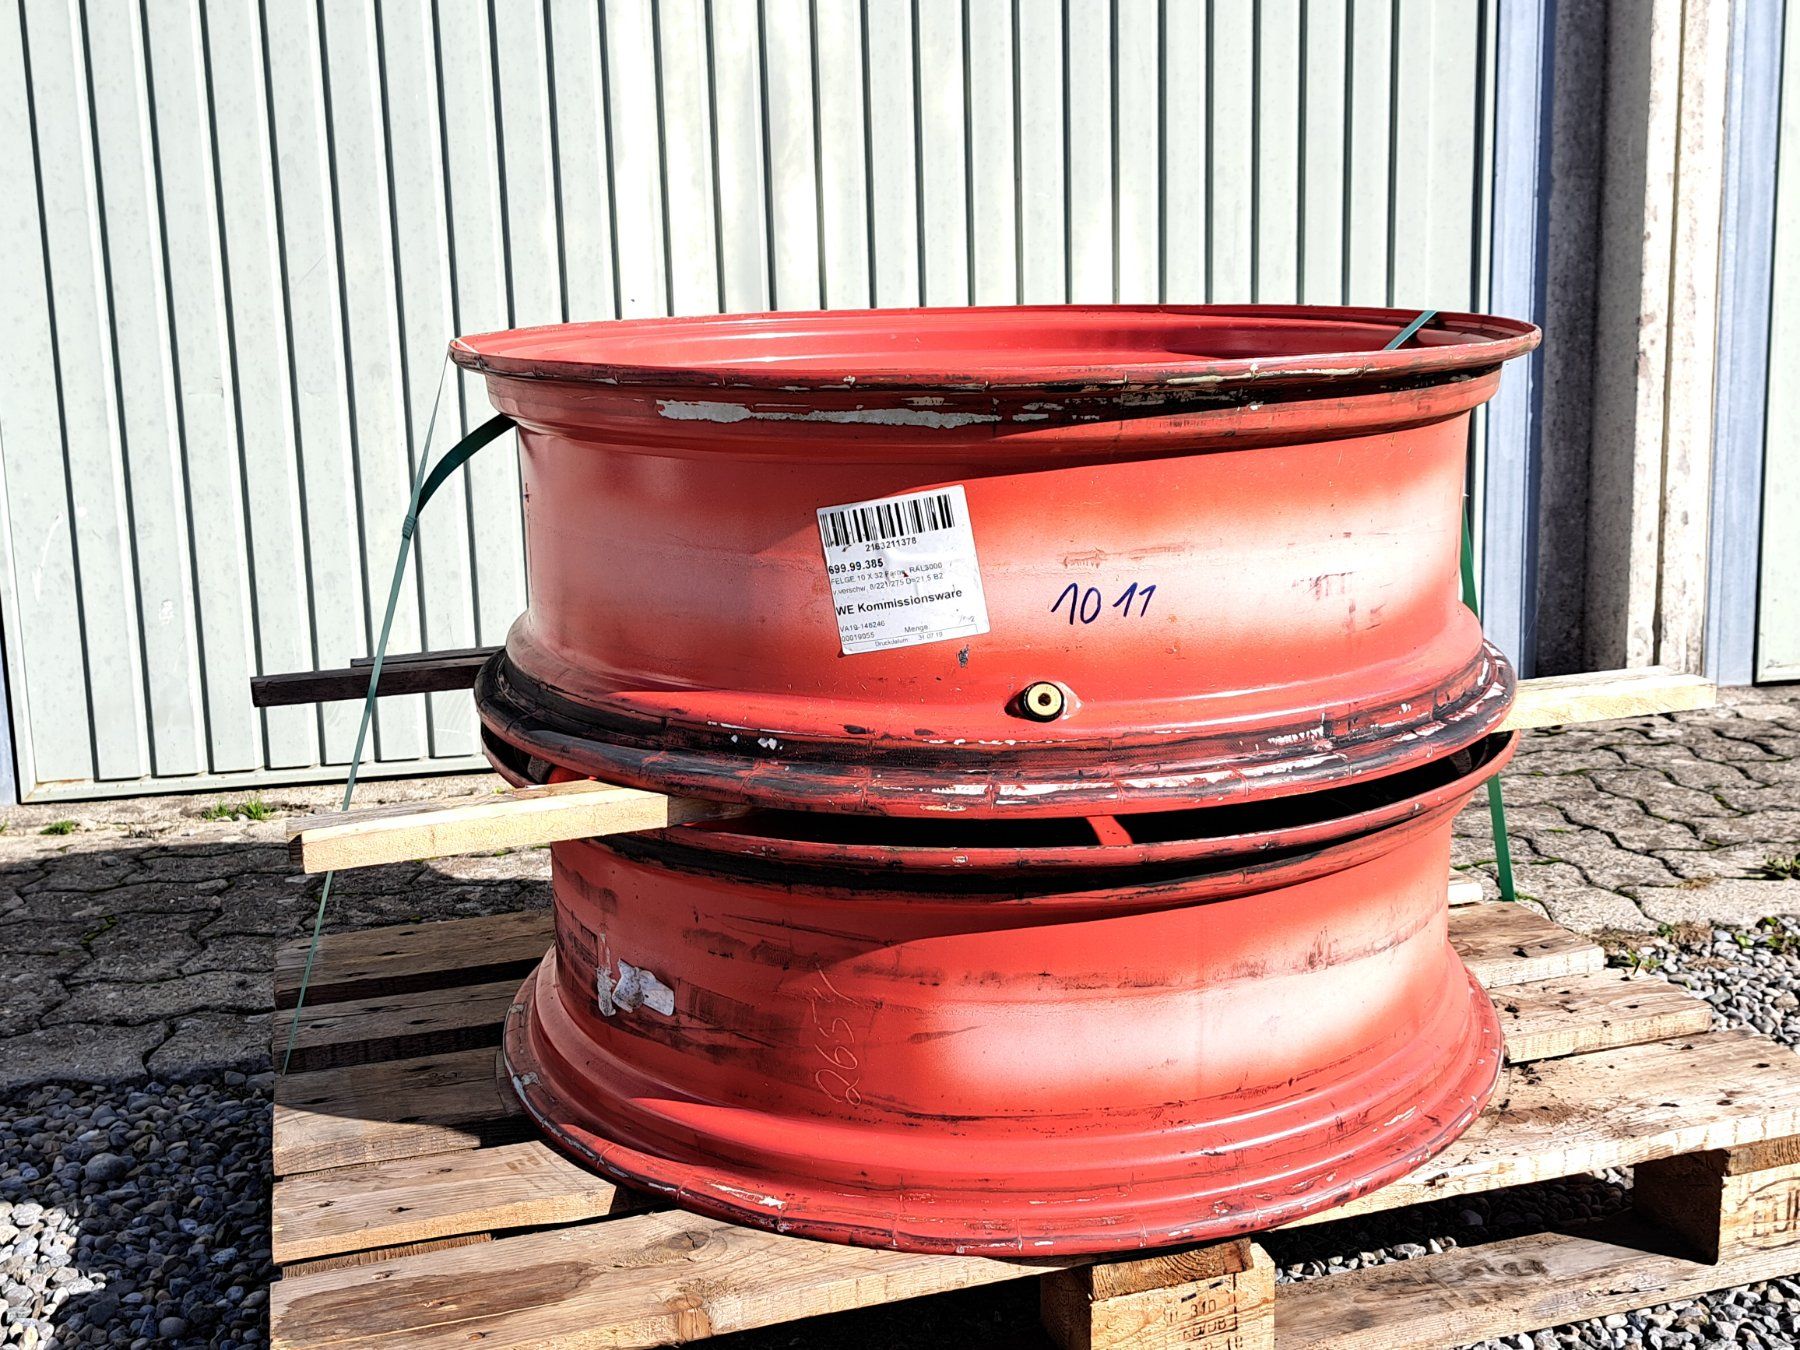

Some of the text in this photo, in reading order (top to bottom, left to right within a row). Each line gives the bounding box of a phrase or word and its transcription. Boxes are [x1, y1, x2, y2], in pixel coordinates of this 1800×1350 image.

[828, 558, 884, 575] 699.99.385
[831, 575, 856, 586] FELGE
[857, 574, 866, 582] 10
[874, 571, 884, 579] 32
[909, 562, 942, 573] RAL3000
[835, 589, 963, 616] WE Kommissionsware
[1051, 582, 1156, 625] 10 11
[904, 624, 929, 634] Menge
[874, 638, 909, 648] Druckdatum
